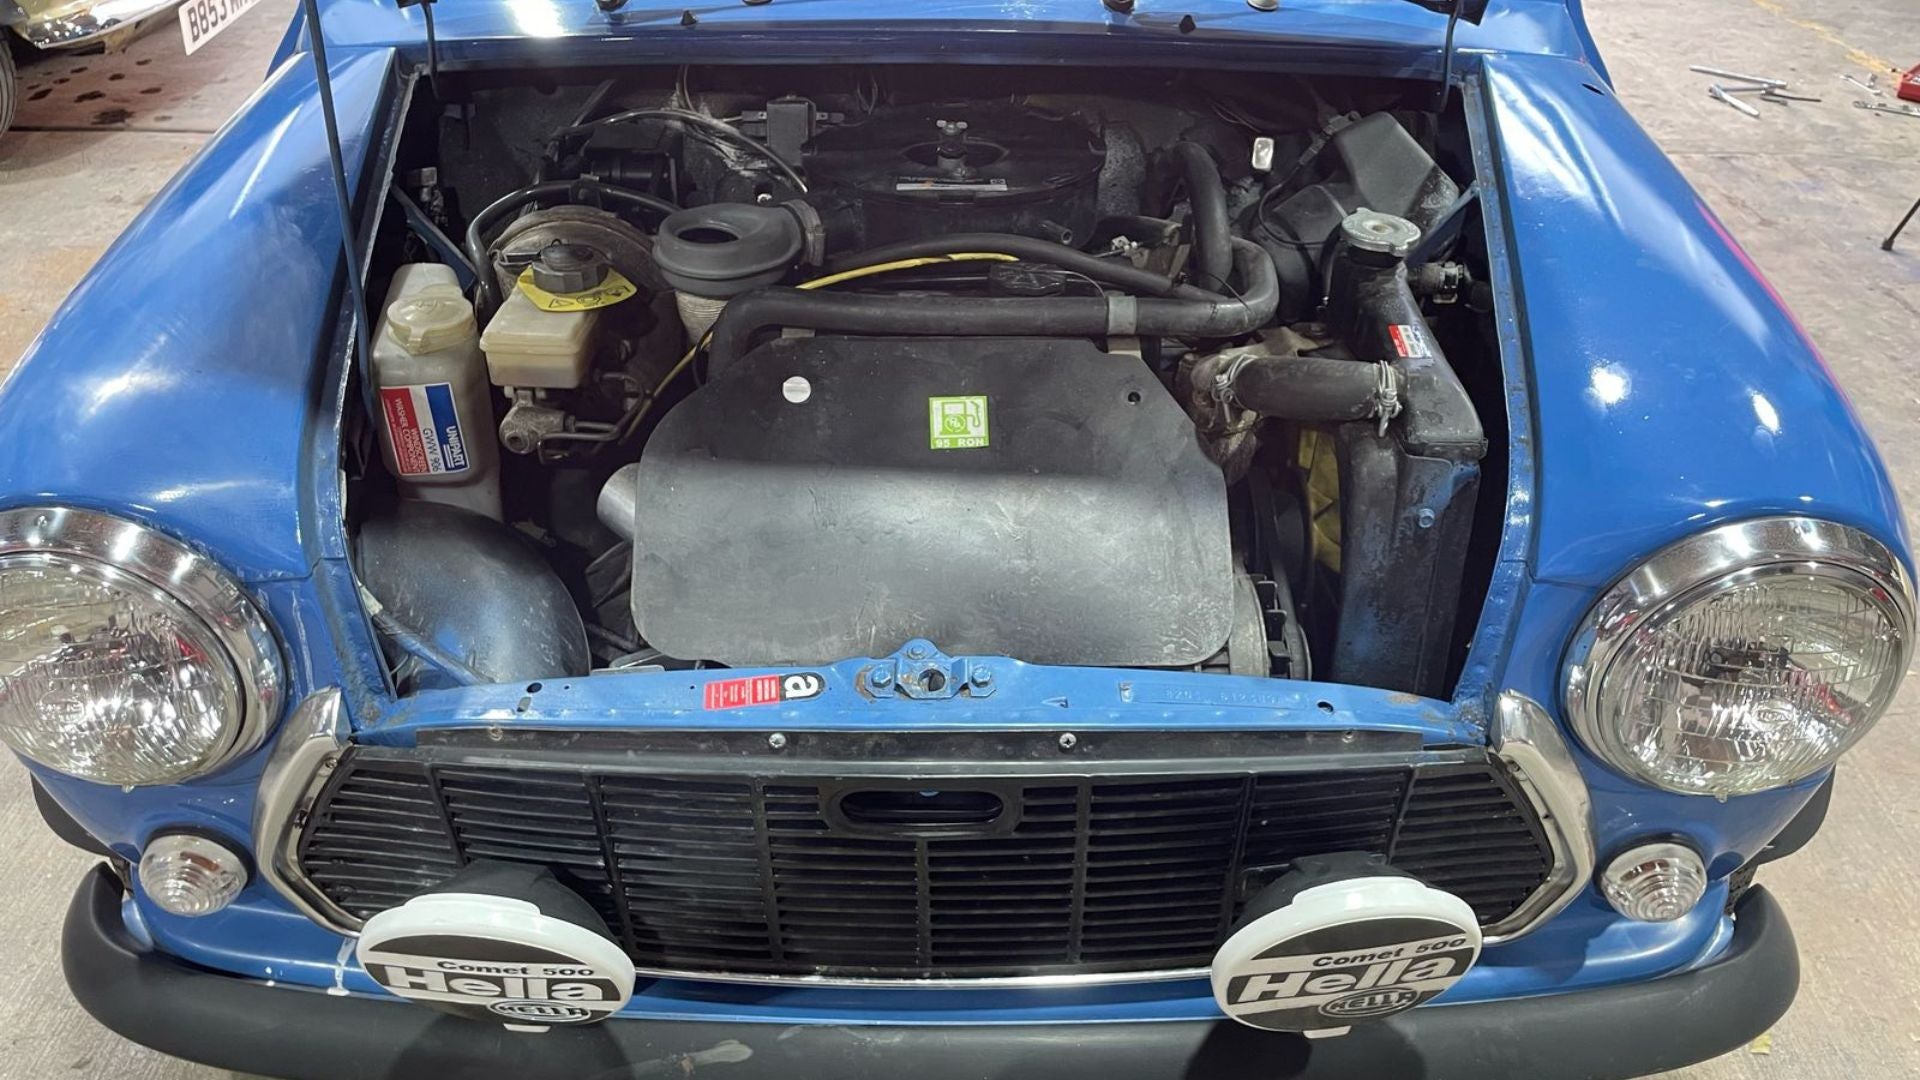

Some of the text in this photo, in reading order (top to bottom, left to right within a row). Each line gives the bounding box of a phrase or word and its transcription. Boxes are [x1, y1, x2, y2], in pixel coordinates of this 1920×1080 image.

[187, 0, 227, 42] B853
[395, 398, 409, 428] WASHER
[423, 427, 438, 455] GWW
[445, 425, 465, 466] UNIPART
[957, 437, 985, 448] RON
[1313, 938, 1467, 968] Comet 500
[384, 965, 603, 1001] Hella
[437, 960, 595, 977] Comet 500
[1237, 957, 1456, 1003] Hella
[497, 1004, 588, 1017] HELLA
[1328, 989, 1416, 1011] HELLA
